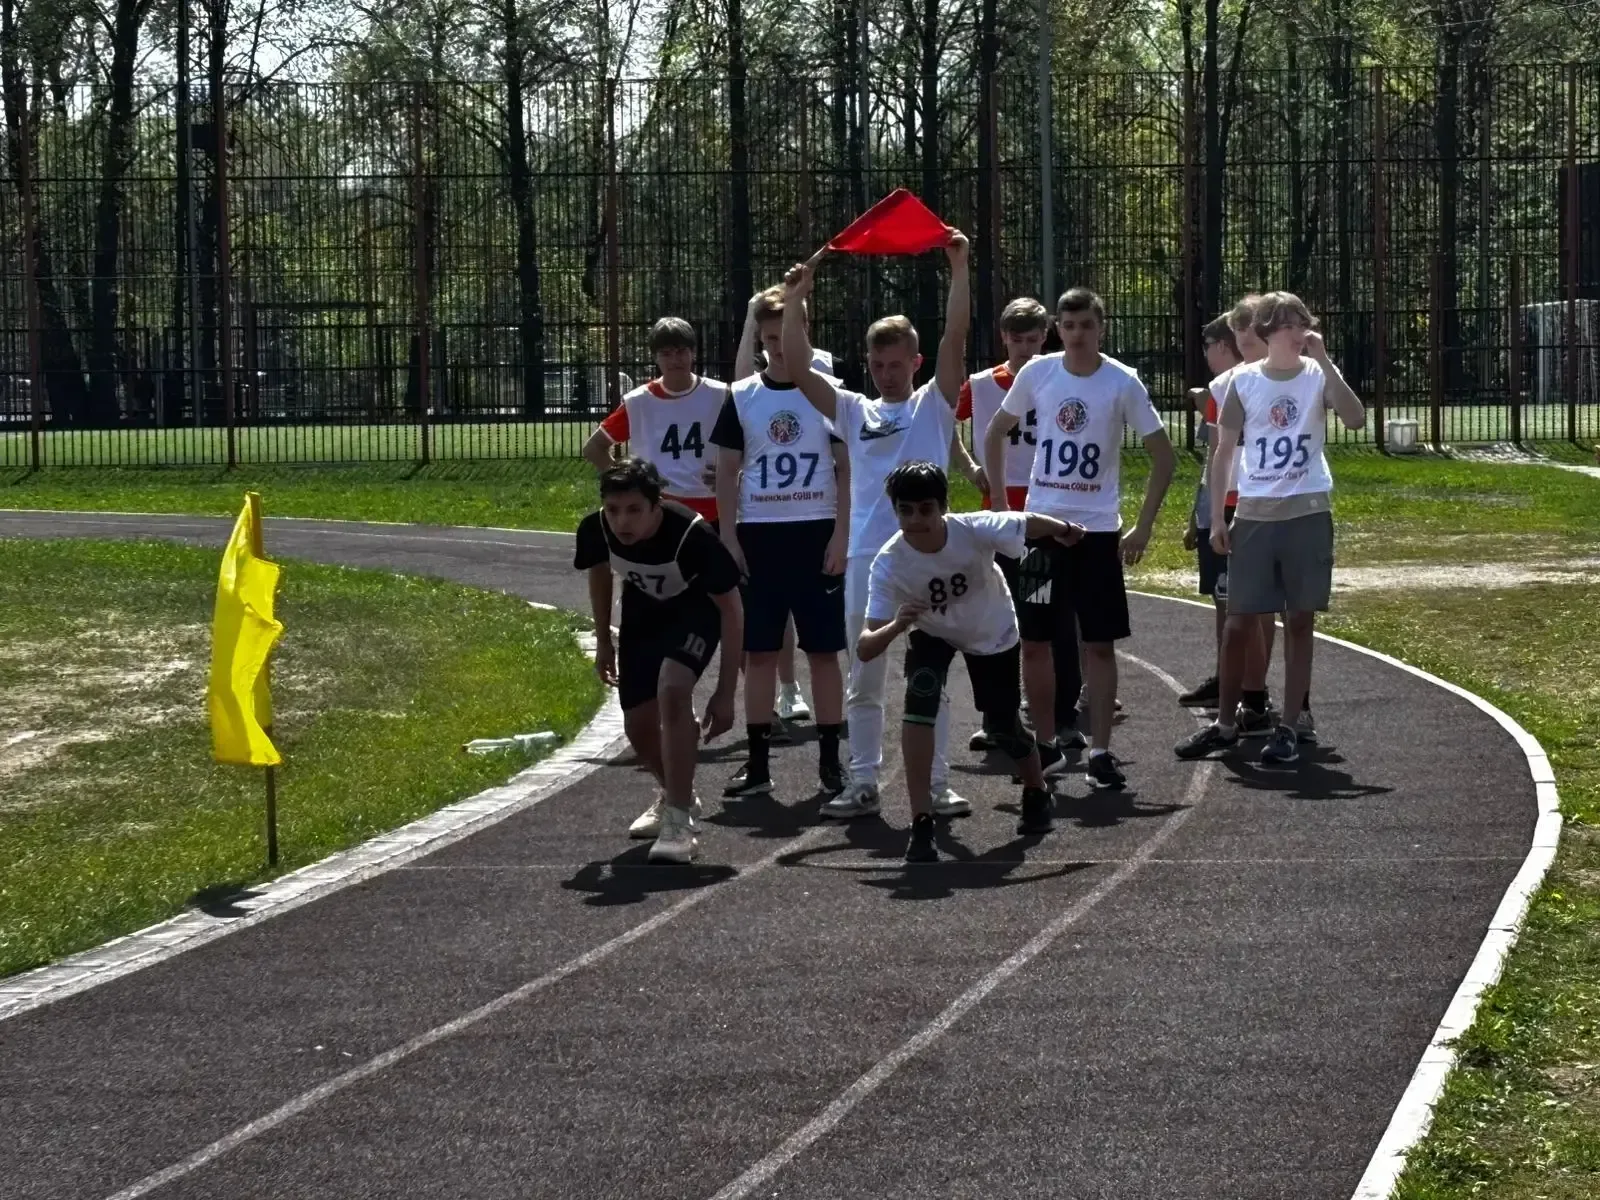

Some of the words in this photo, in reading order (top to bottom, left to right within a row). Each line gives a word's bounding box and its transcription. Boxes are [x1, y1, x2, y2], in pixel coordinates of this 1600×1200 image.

[661, 422, 704, 459] 44
[1256, 434, 1311, 469] 195
[756, 452, 819, 489] 197
[1042, 439, 1100, 479] 198
[627, 571, 666, 594] 87
[928, 572, 968, 603] 88
